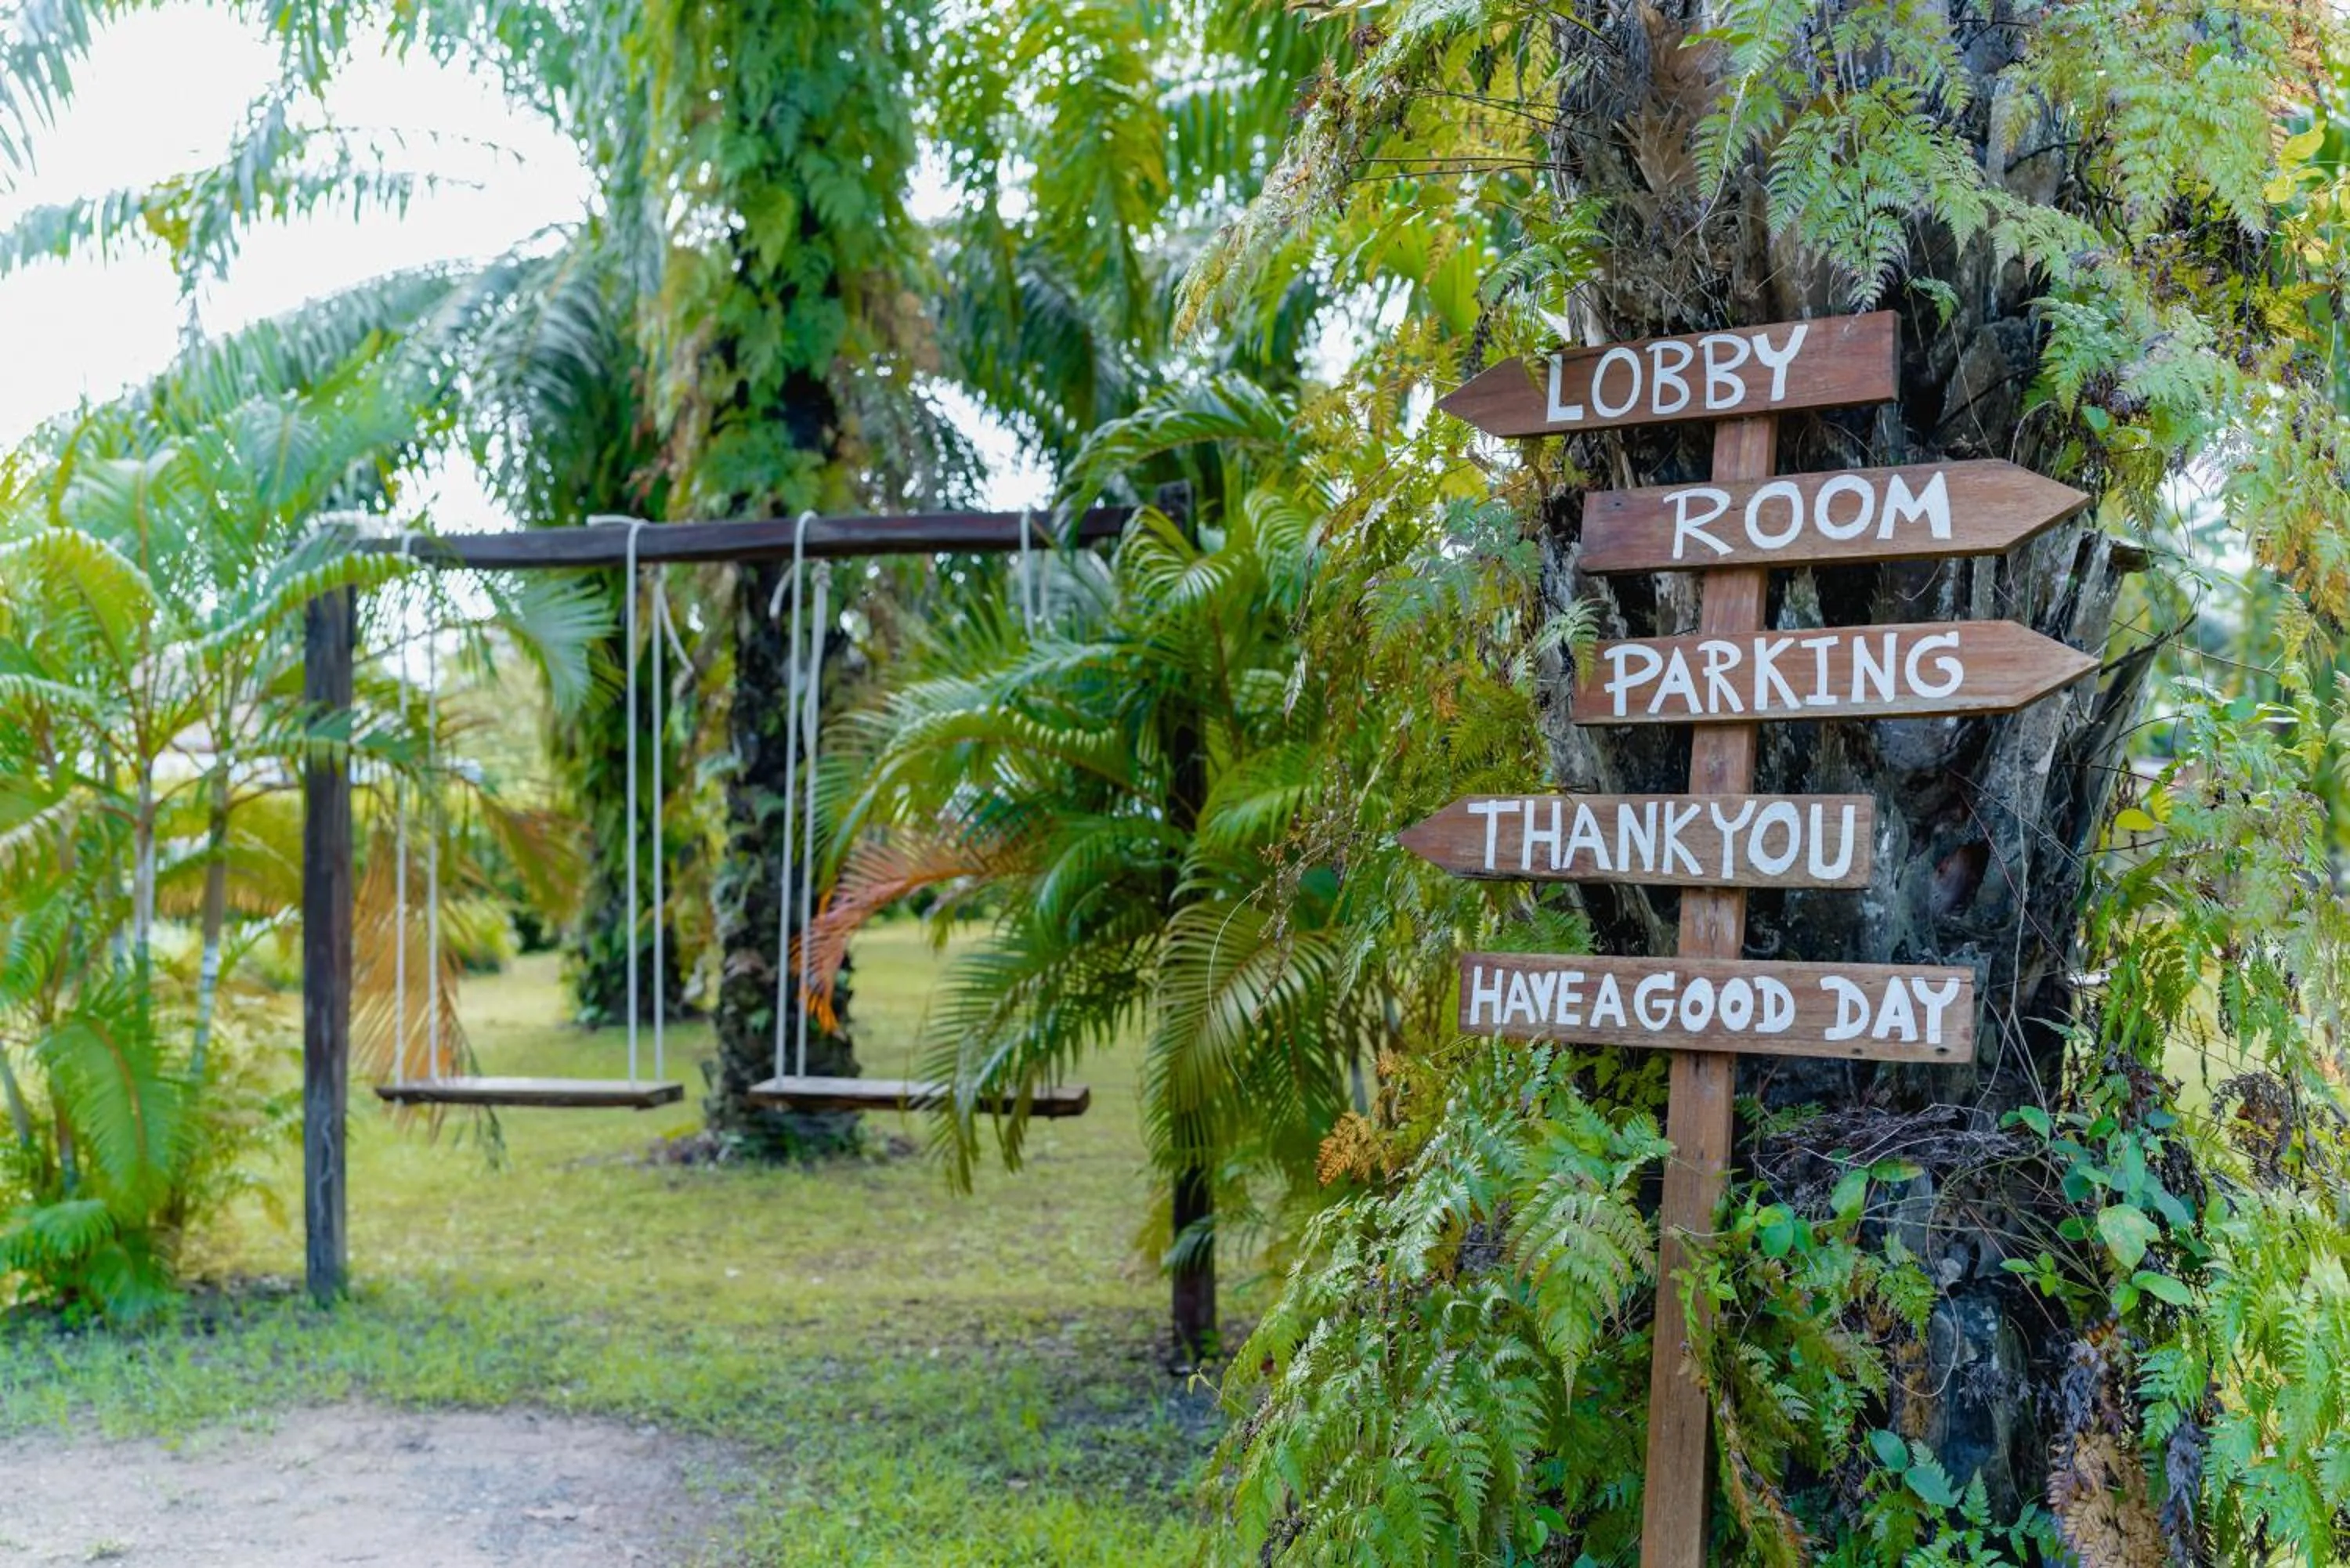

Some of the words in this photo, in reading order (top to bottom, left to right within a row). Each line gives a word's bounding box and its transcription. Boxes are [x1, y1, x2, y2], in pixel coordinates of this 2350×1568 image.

[1546, 323, 1809, 423] LOBBY
[1663, 471, 1952, 560] ROOM
[1603, 630, 1965, 717] PARKING
[1467, 799, 1703, 876] THANK
[1710, 799, 1856, 880] YOU
[1469, 966, 1585, 1026] HAVE
[1589, 972, 1628, 1028] A
[1633, 970, 1796, 1033] GOOD
[1820, 975, 1961, 1044] DAY
